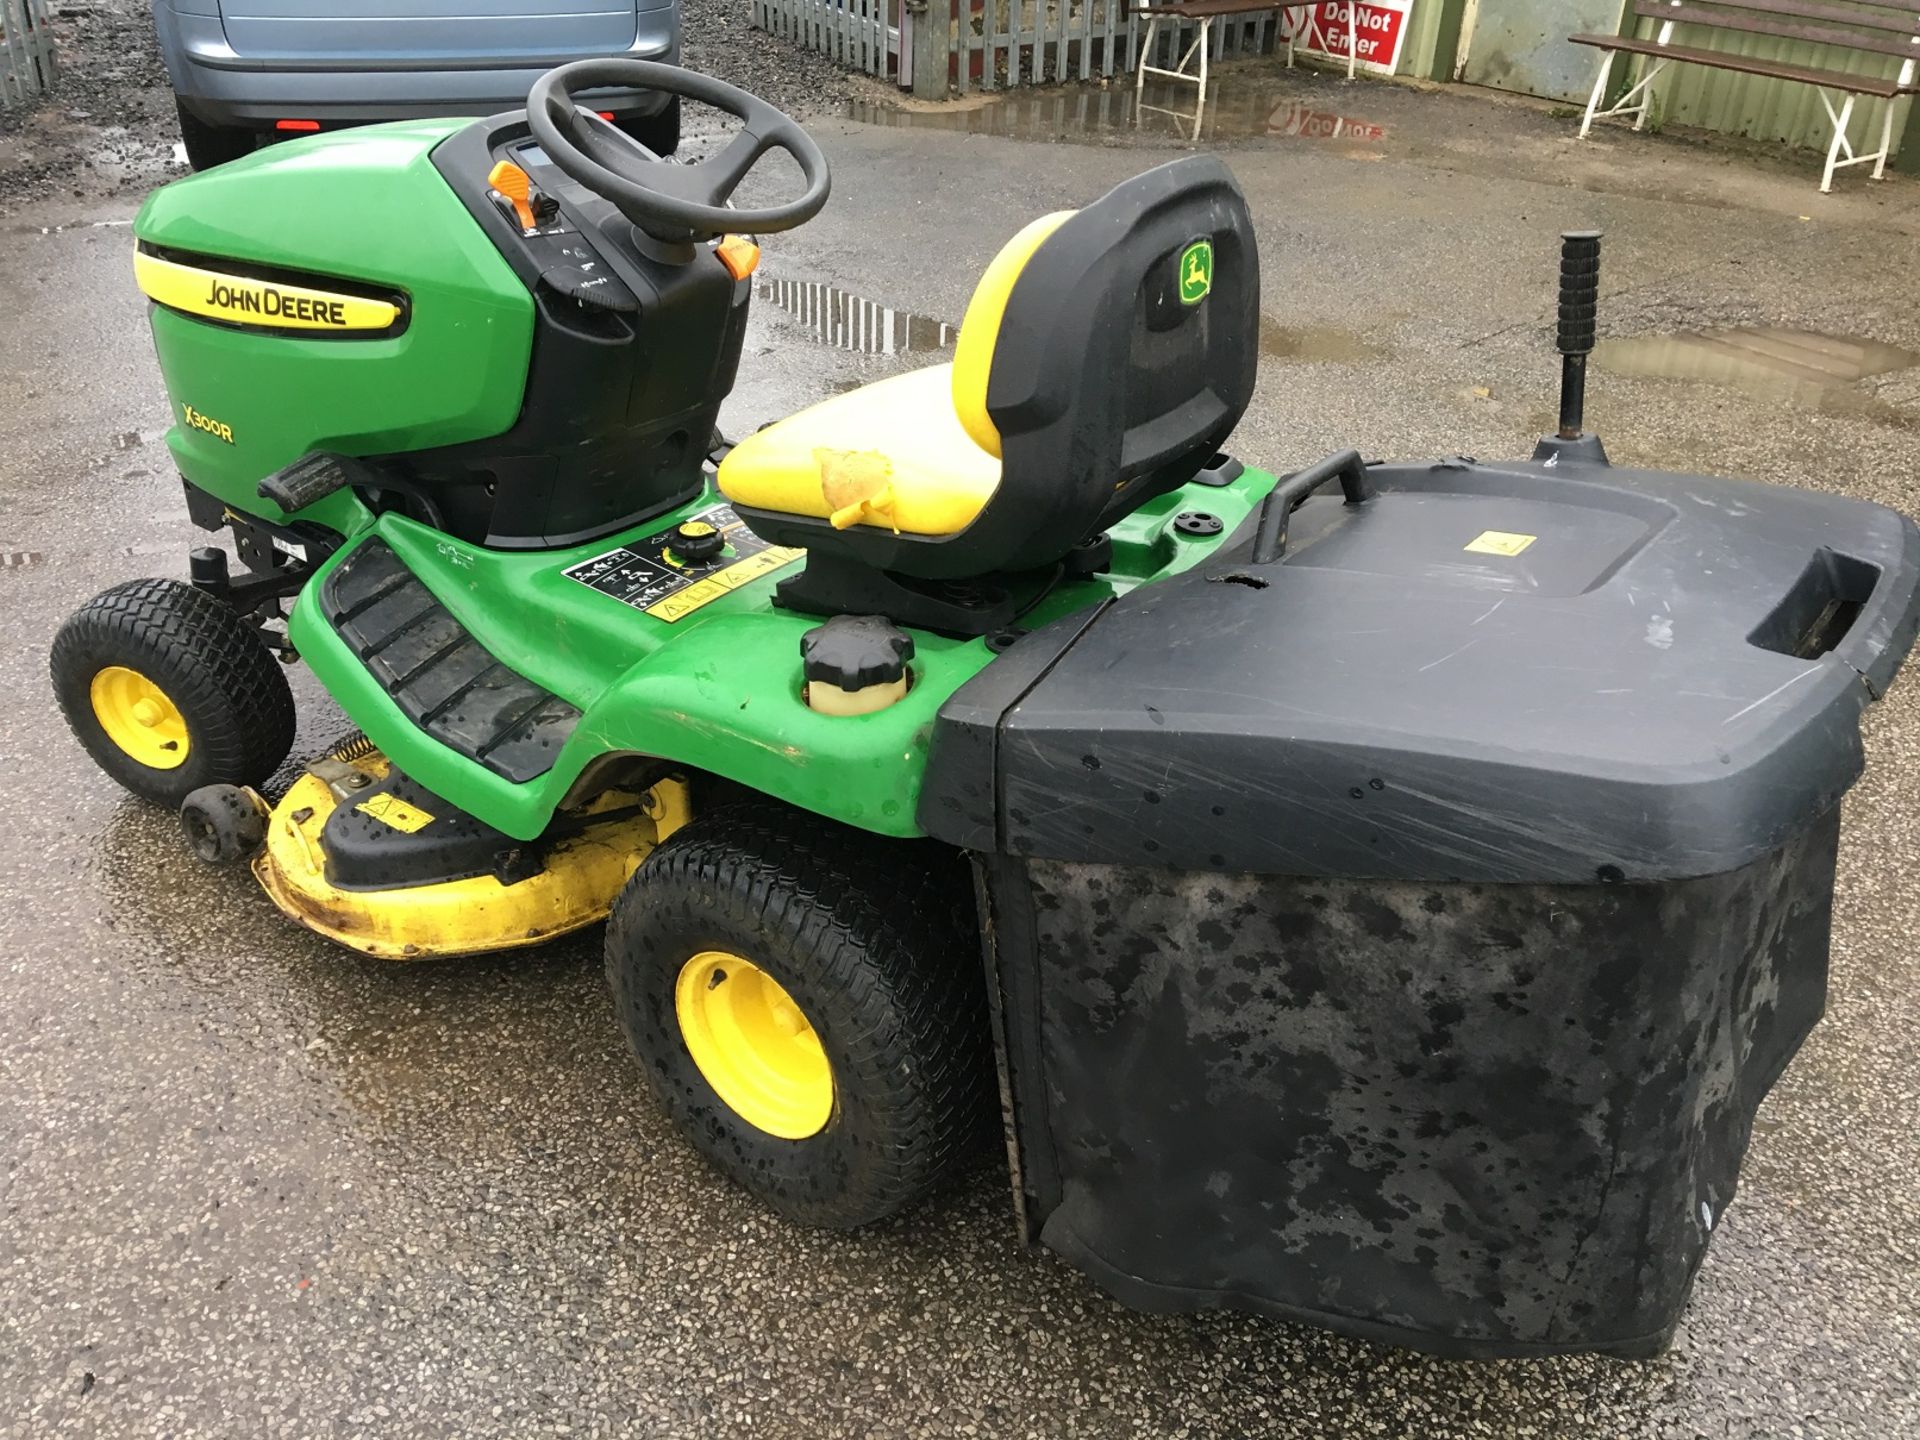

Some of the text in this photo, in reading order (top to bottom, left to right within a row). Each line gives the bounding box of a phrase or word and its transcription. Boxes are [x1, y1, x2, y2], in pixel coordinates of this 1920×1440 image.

[1324, 2, 1392, 32] Do Not
[206, 279, 346, 325] JOHN DEERE
[182, 402, 234, 443] X300R
